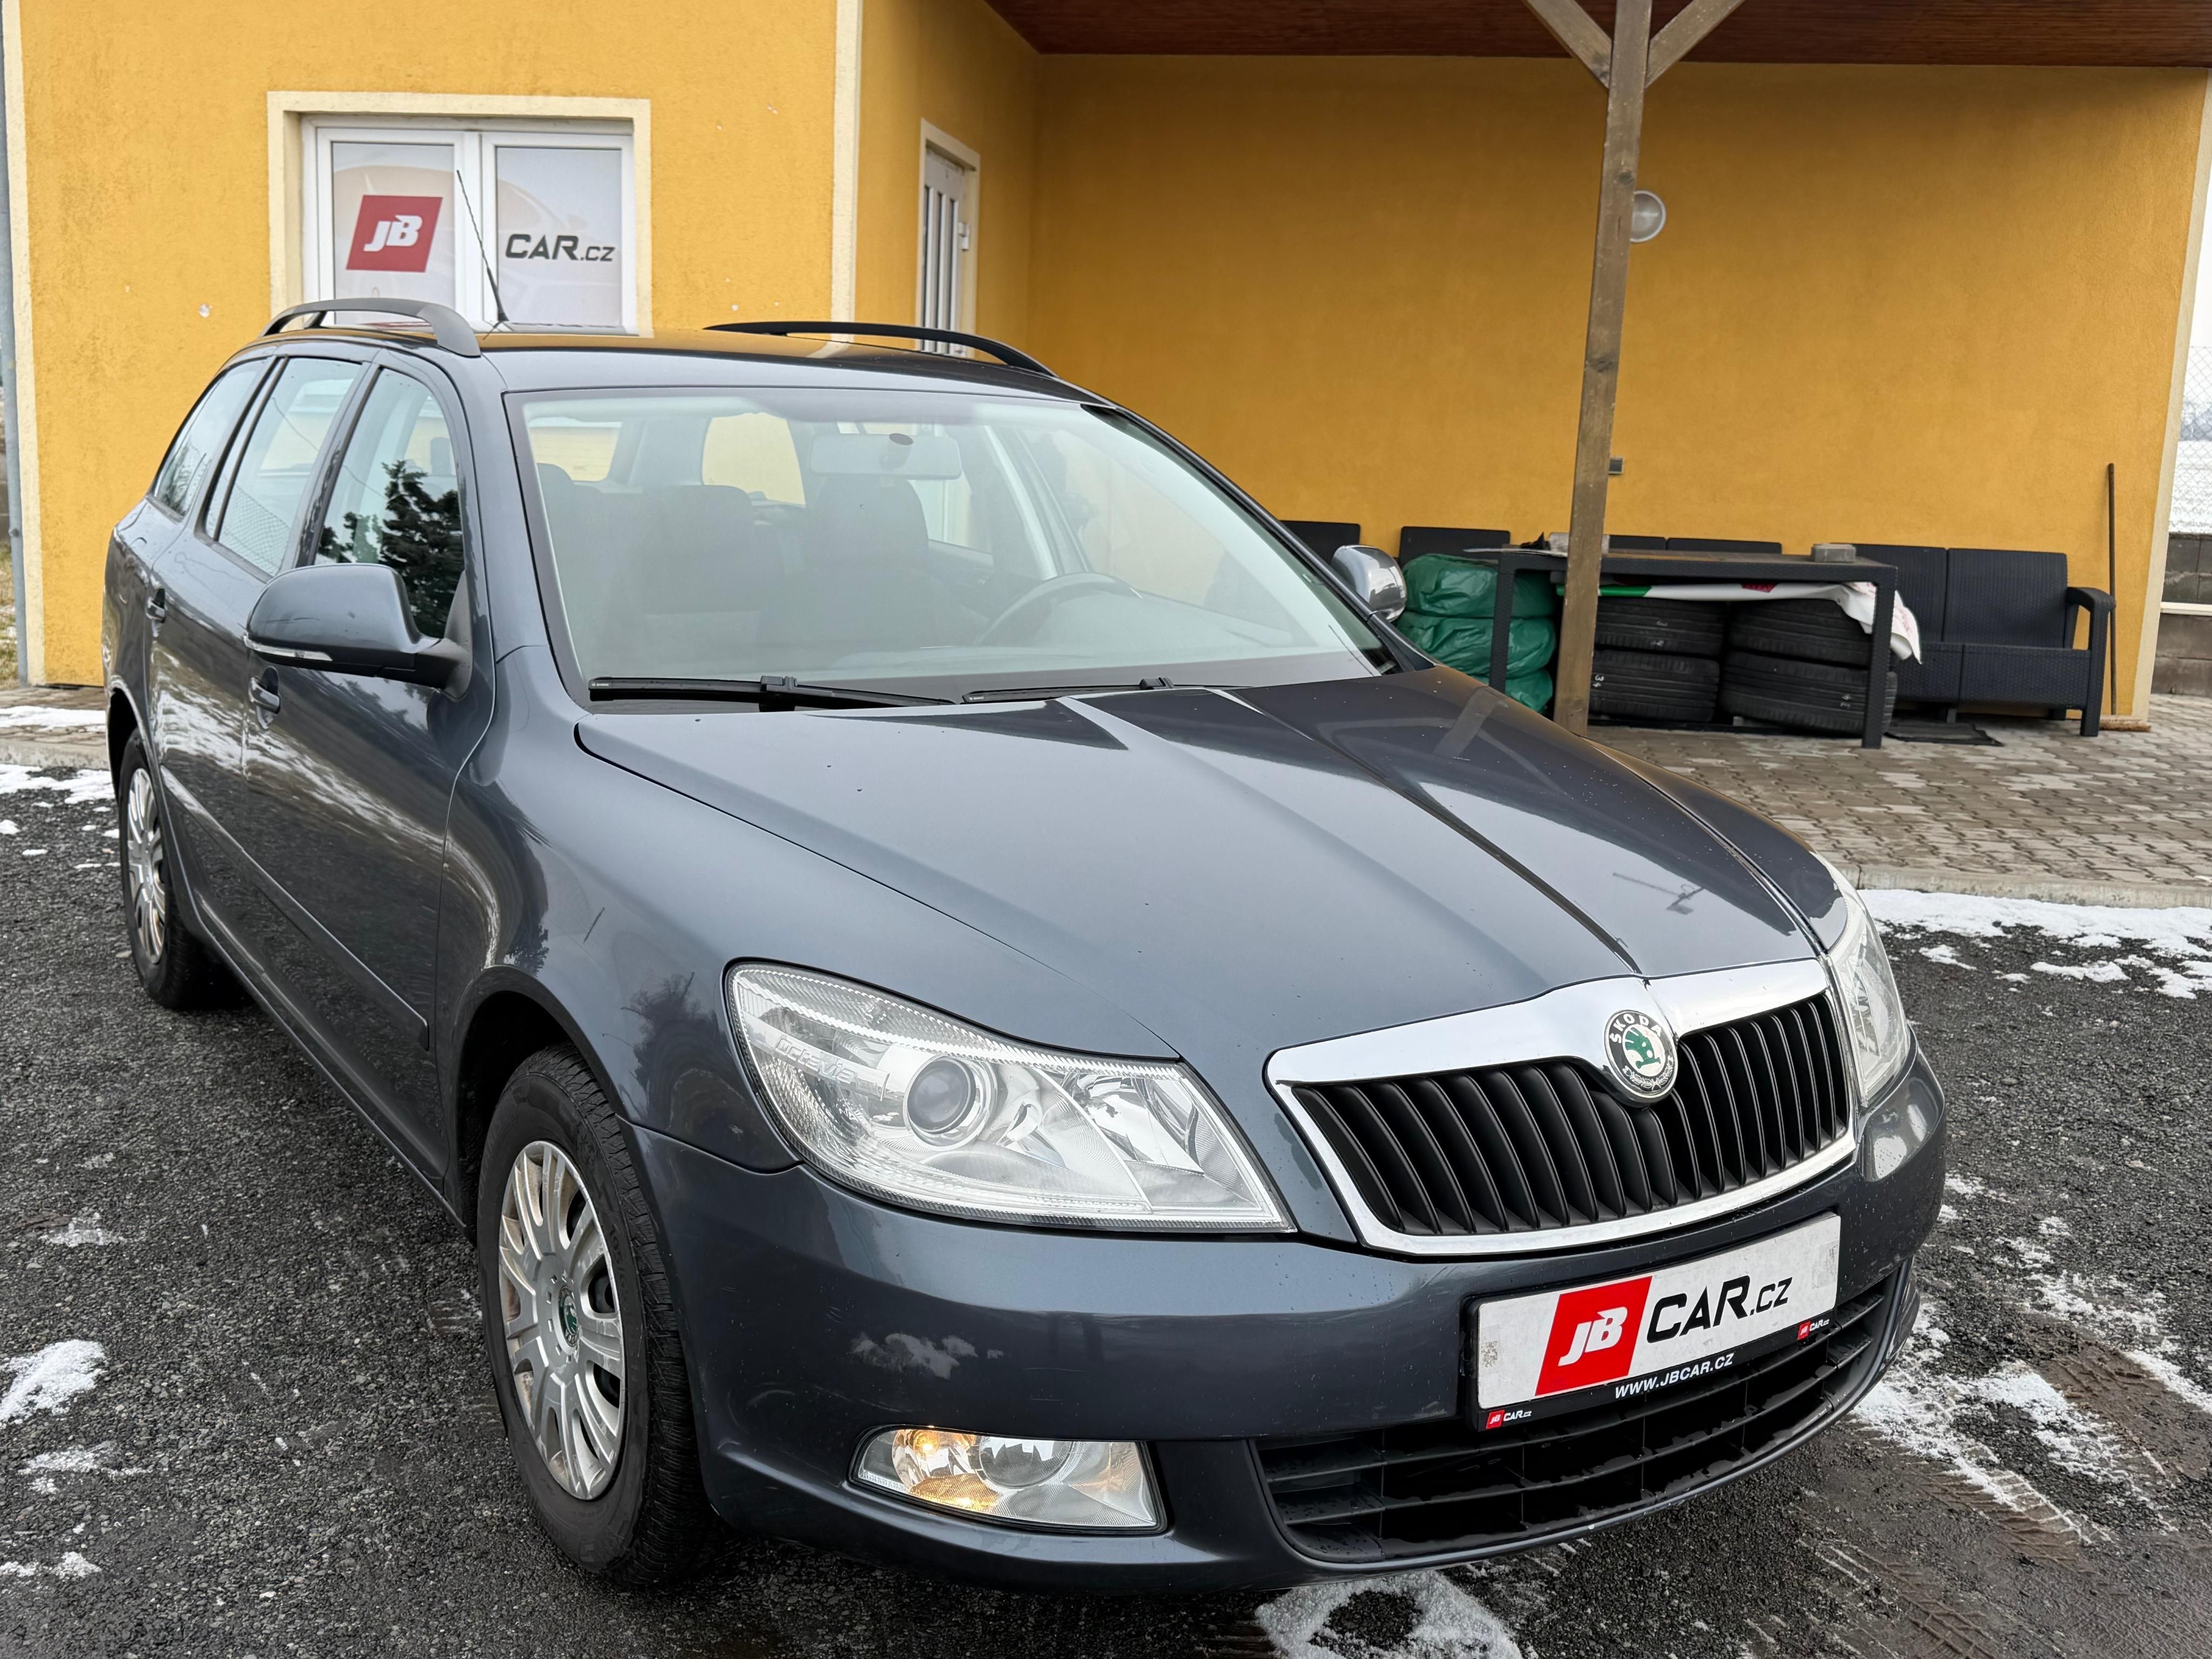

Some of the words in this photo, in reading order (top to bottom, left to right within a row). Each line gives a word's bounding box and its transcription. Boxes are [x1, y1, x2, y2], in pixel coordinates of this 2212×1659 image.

[363, 214, 423, 252] JB
[1609, 1013, 1663, 1044] ŠKODA
[1557, 1306, 1628, 1367] JB
[1615, 1352, 1735, 1399] WWW.JBCAR.CZ
